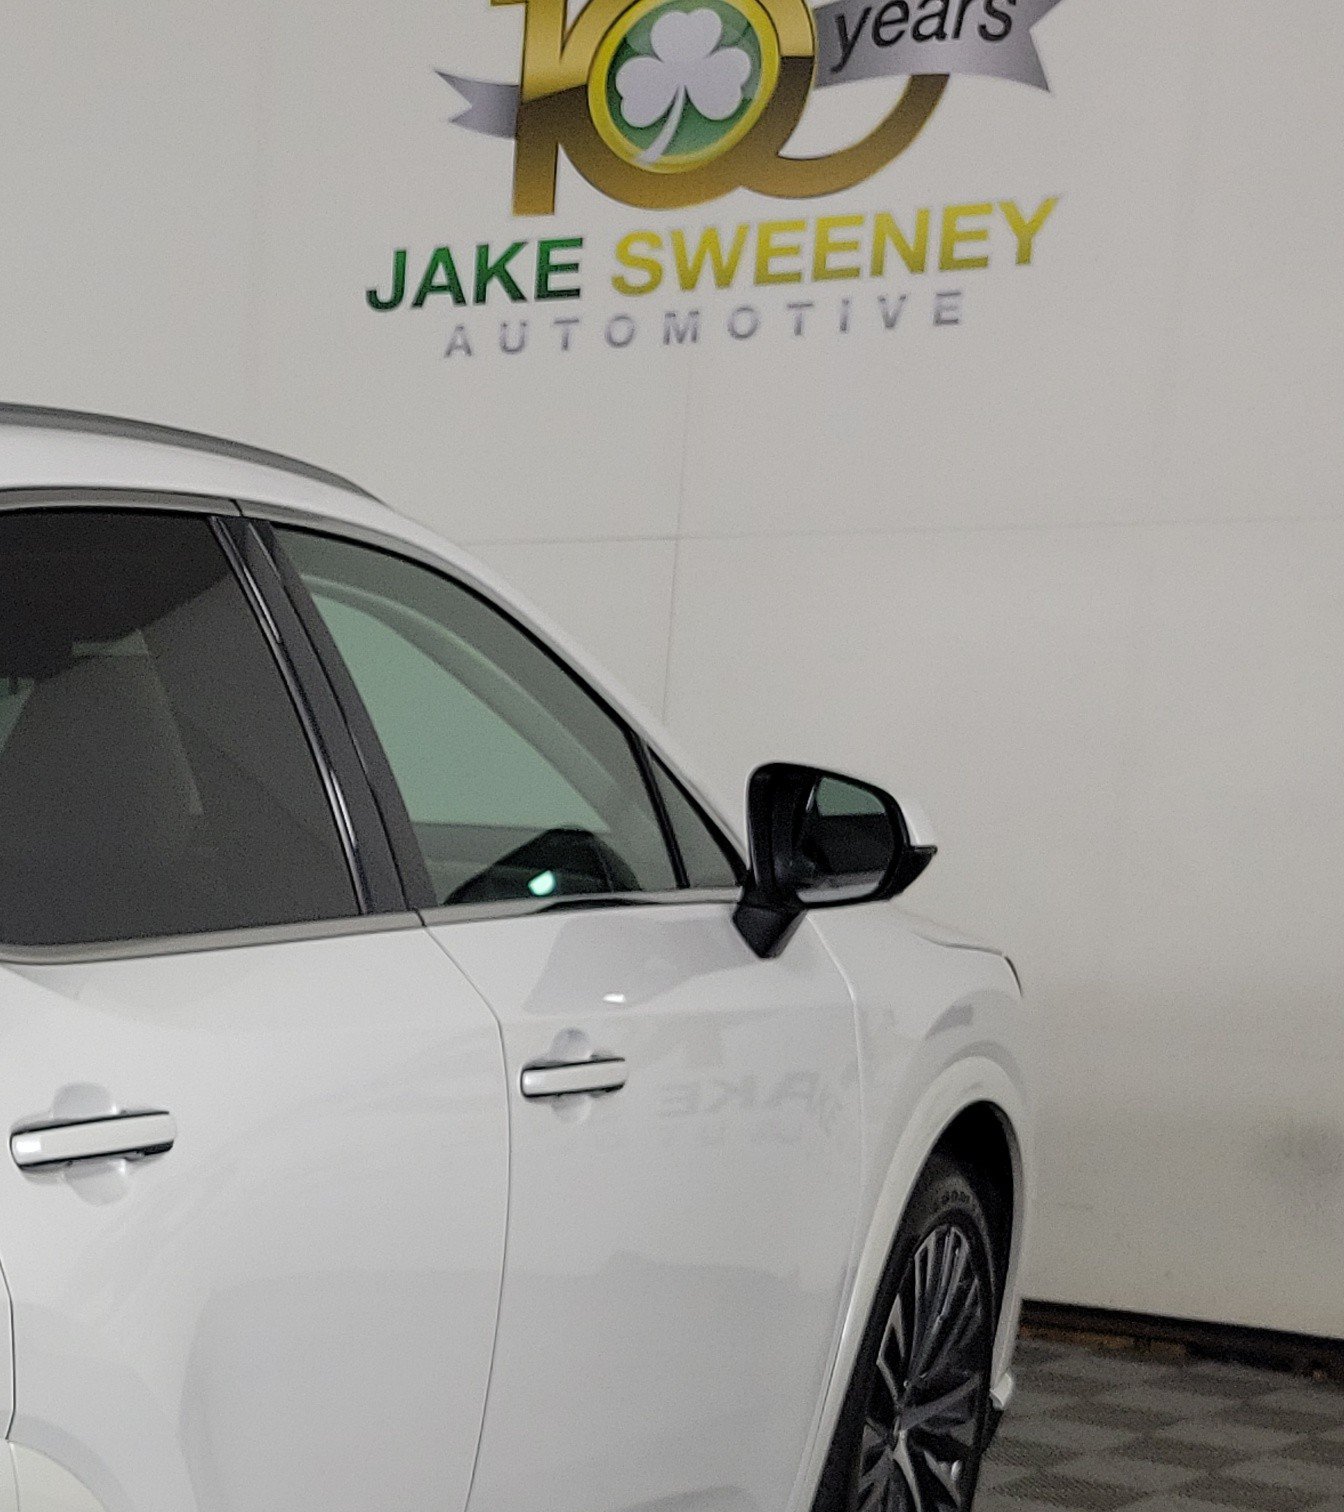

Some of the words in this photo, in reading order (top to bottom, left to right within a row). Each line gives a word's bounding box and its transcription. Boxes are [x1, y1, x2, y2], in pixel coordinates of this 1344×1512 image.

[832, 0, 1014, 74] years
[365, 236, 585, 313] JAKE
[611, 197, 1060, 297] SWEENEY
[444, 289, 964, 359] AUTOMOTIVE
